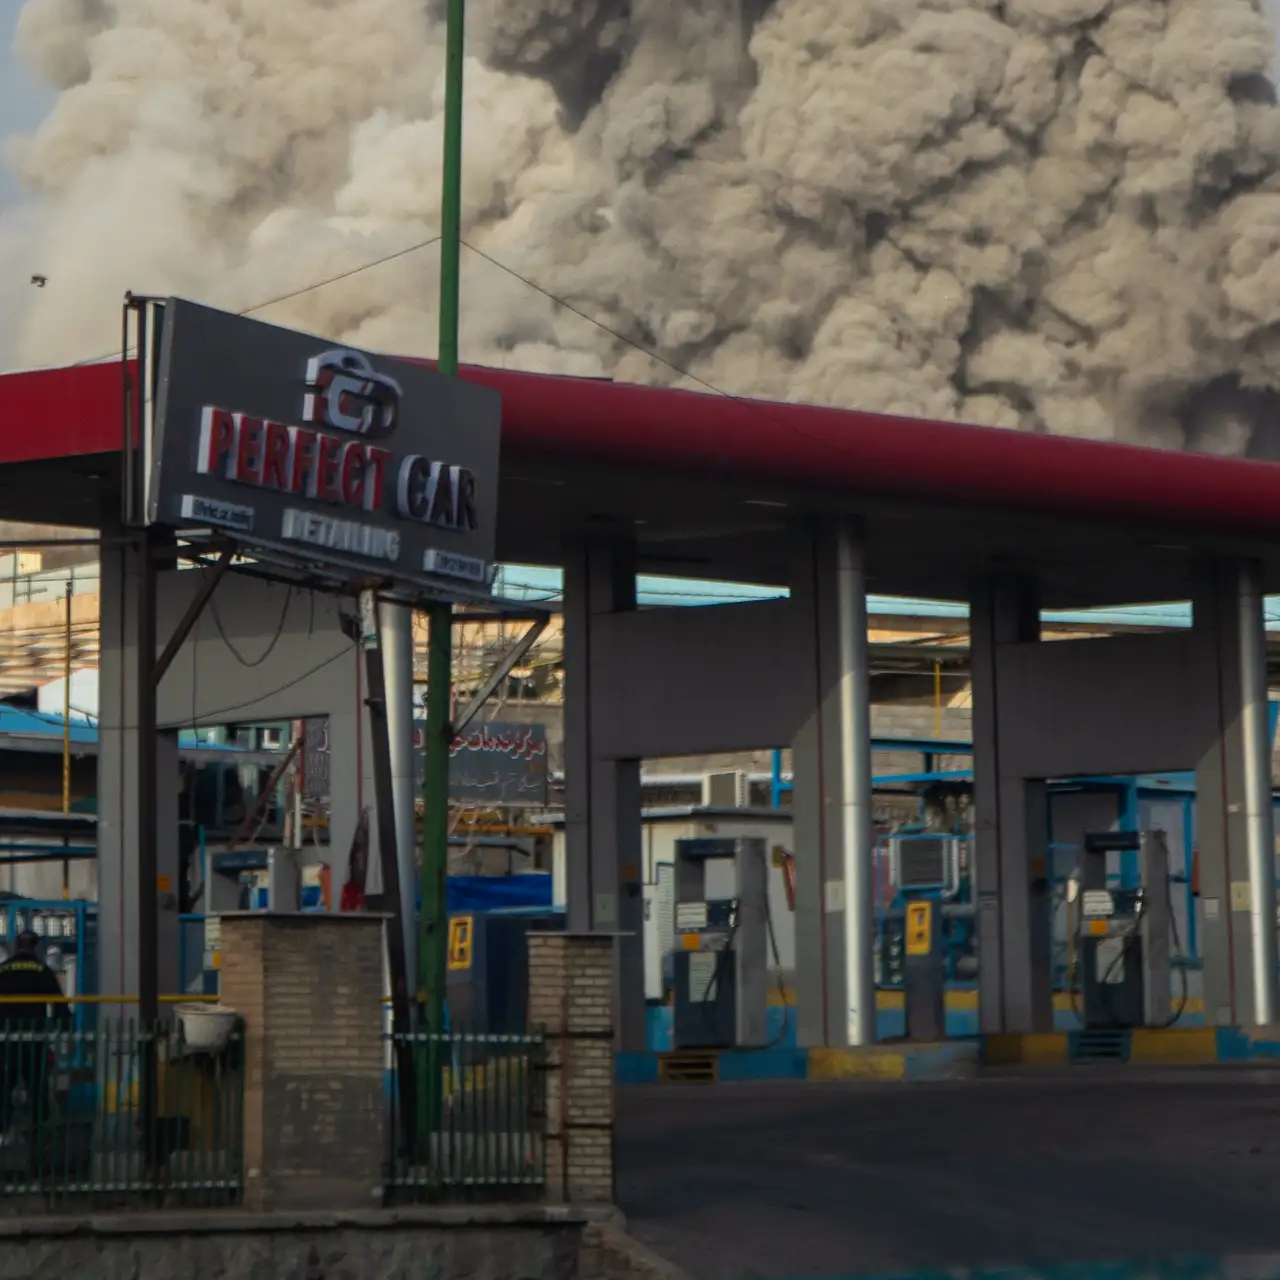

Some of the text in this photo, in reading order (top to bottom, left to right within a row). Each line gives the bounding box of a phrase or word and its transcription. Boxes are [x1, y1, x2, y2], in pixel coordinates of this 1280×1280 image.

[196, 405, 477, 531] PERFECT CAR
[281, 508, 401, 562] DETAILING
